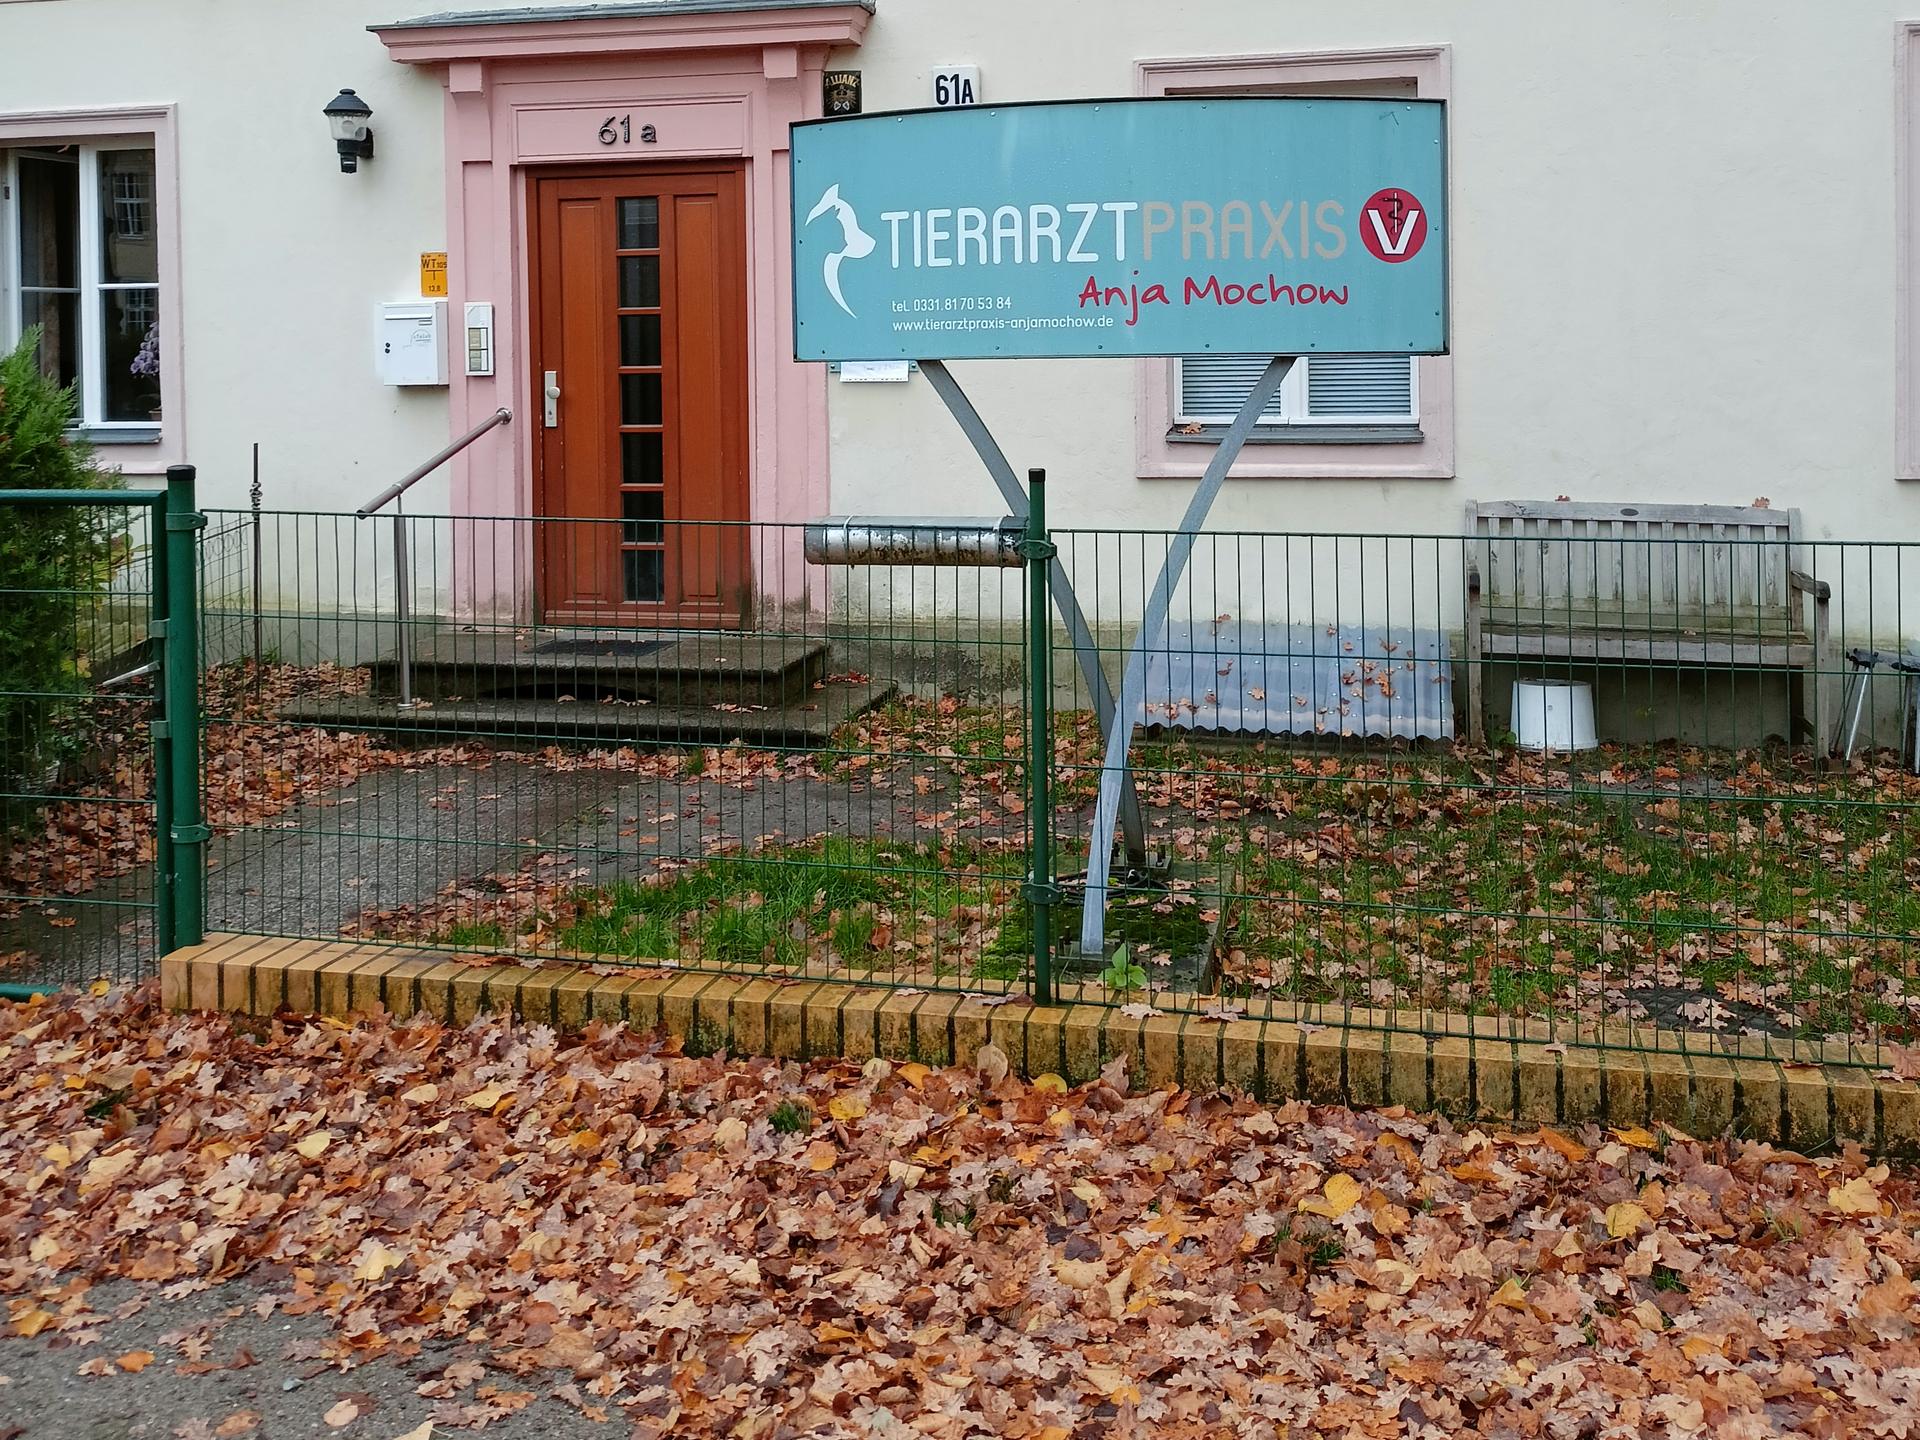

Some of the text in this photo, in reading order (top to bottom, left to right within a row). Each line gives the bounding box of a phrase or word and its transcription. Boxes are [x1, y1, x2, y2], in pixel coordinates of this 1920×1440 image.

[935, 74, 974, 105] 61A
[891, 300, 910, 312] tel.
[1079, 270, 1349, 326] Anja Mochow
[892, 315, 1114, 332] www.tierarztpraxis-anjamochow.de
